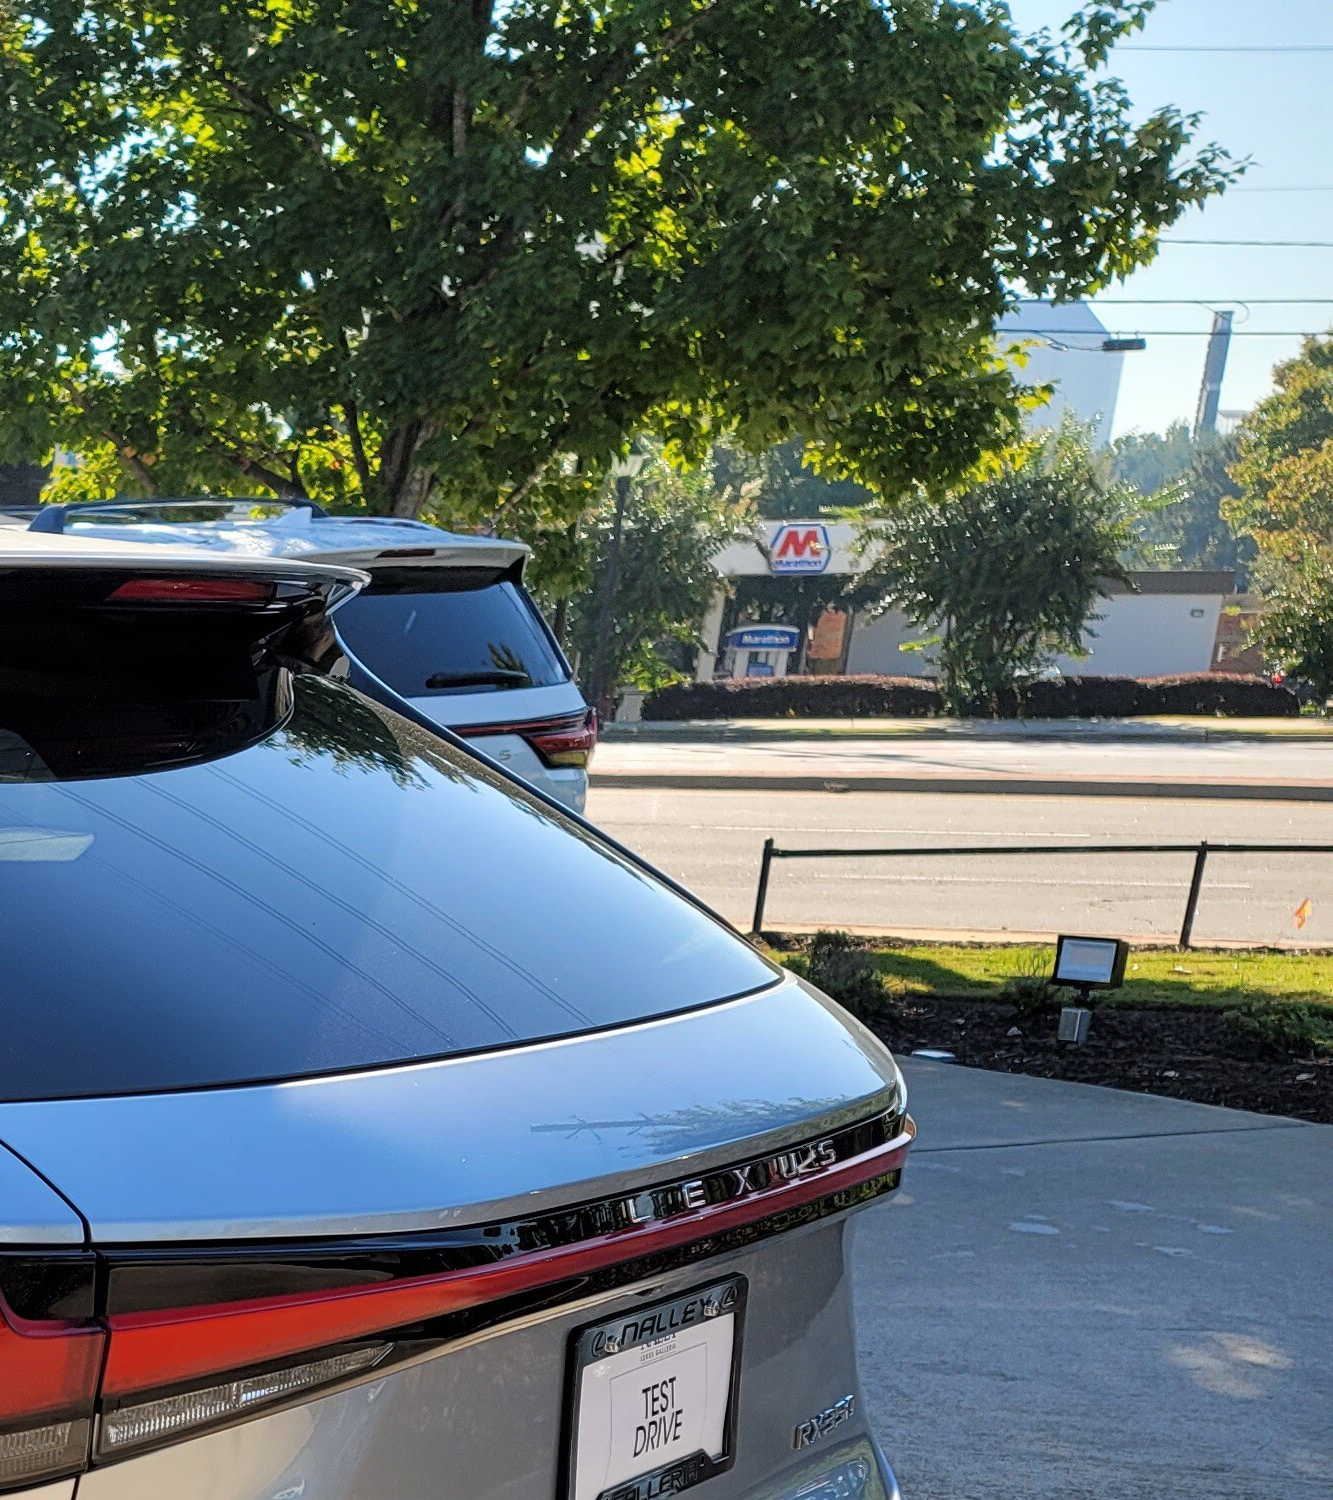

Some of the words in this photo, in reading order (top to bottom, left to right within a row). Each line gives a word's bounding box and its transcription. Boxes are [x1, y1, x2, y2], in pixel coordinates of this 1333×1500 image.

[777, 530, 821, 558] M
[742, 634, 790, 644] Marathon
[626, 1139, 836, 1224] LEXUS
[619, 1294, 713, 1346] NALLEY
[642, 1376, 677, 1419] TEST
[633, 1409, 683, 1458] DRIVE
